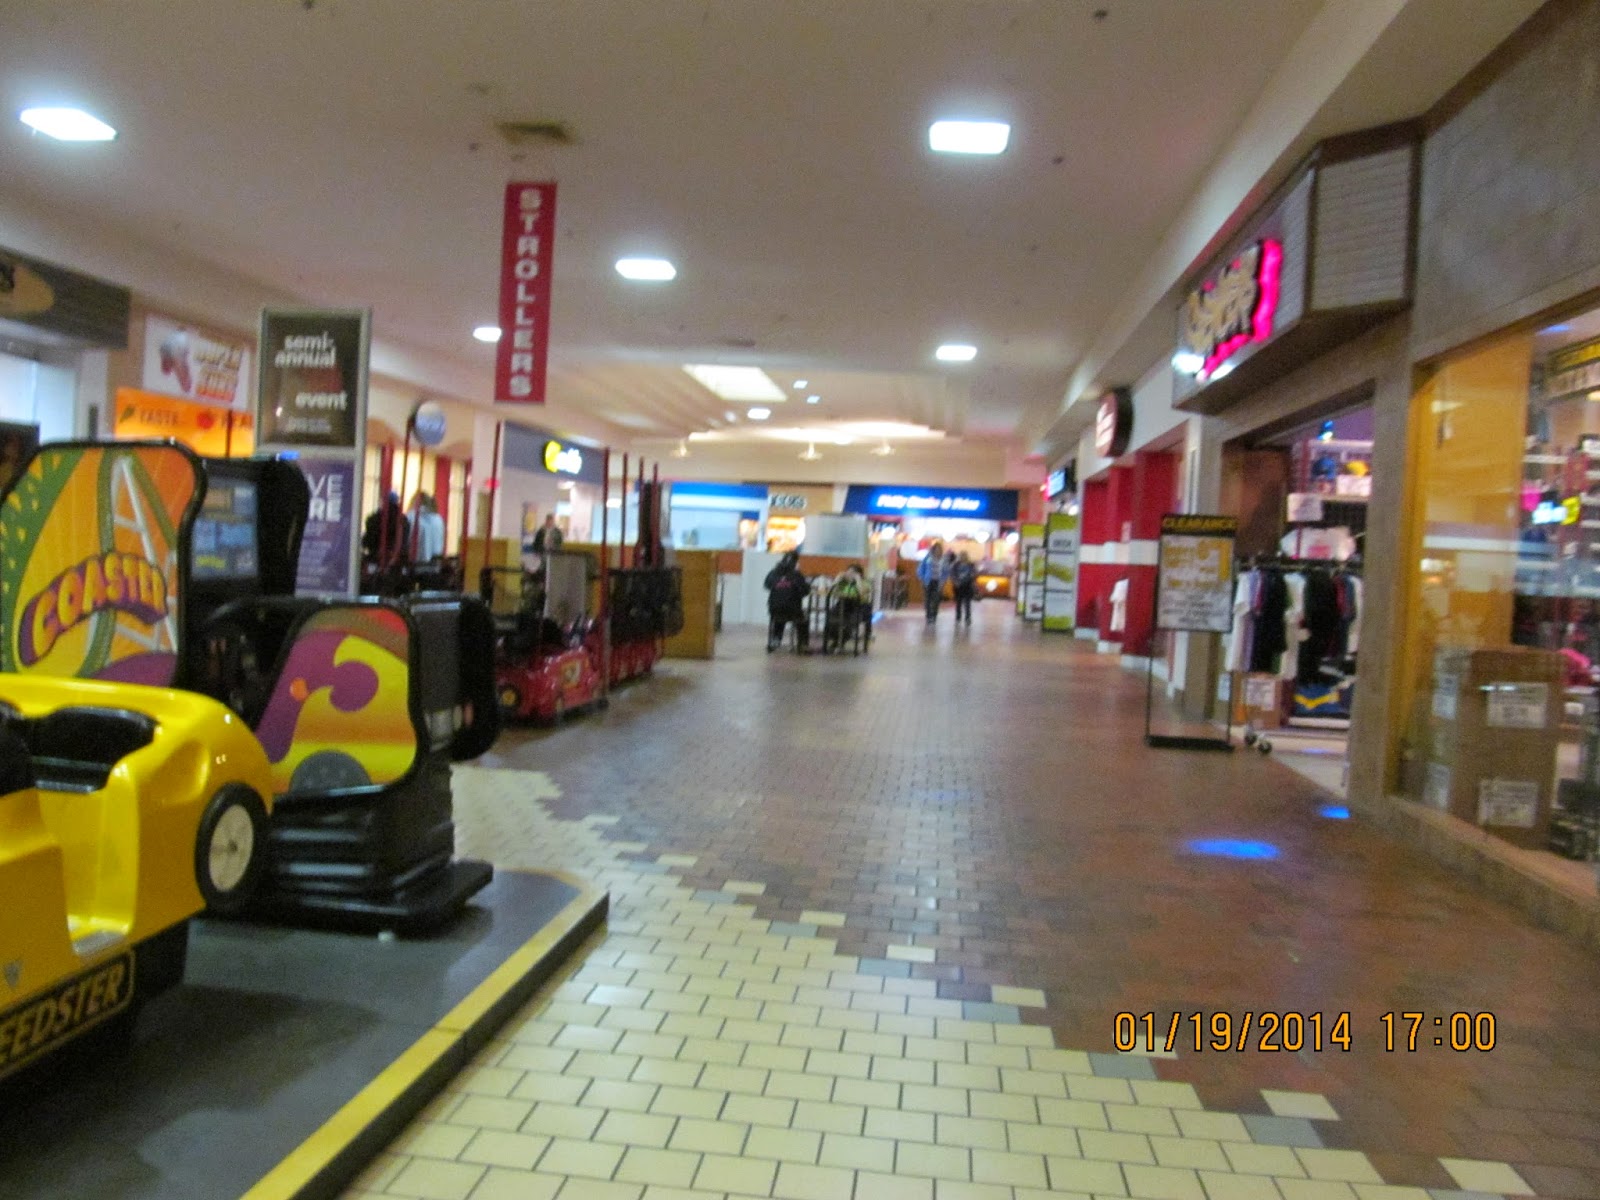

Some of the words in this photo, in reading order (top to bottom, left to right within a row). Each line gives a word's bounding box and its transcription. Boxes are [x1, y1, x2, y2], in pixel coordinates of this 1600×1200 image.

[508, 188, 542, 397] STROLLERS
[275, 346, 336, 368] annual
[296, 390, 348, 411] event
[1162, 517, 1238, 530] CLEARANCE
